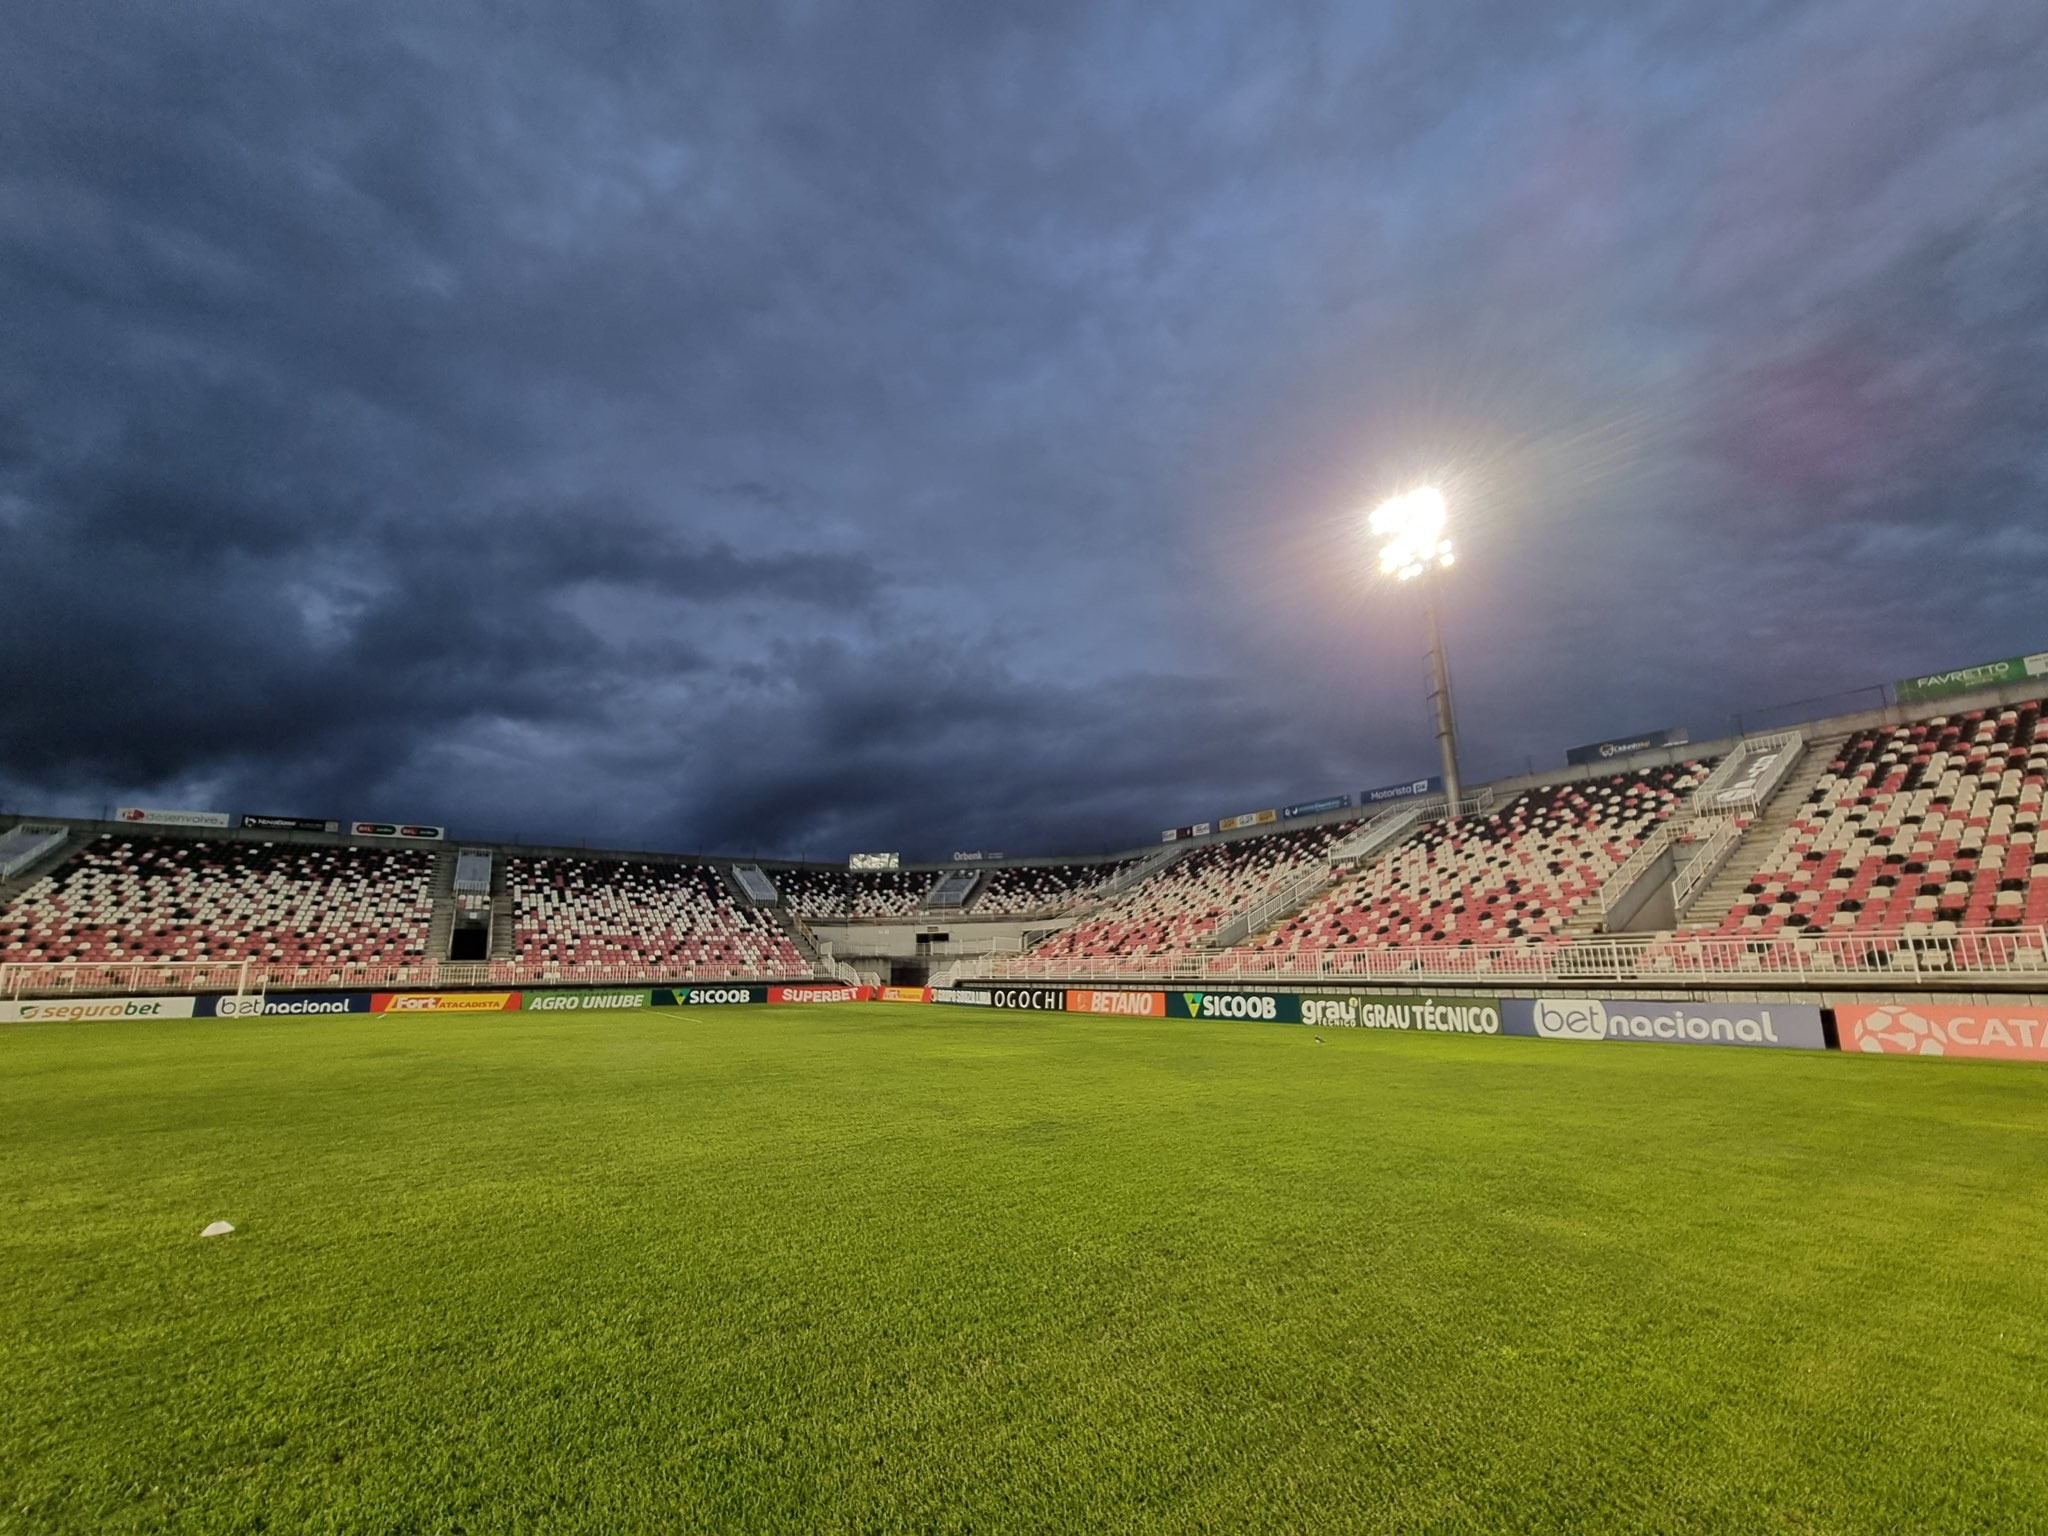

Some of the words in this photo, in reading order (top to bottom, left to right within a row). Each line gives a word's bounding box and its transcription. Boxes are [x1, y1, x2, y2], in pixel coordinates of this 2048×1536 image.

[1918, 662, 2009, 688] FAVRETTO
[1371, 786, 1412, 800] Motorista
[528, 996, 578, 1011] AGRO
[582, 994, 645, 1009] UNIUBE
[689, 989, 750, 1004] SICOOB
[782, 988, 858, 1003] SUPERBET
[994, 990, 1064, 1010] OGOCHI
[1090, 991, 1153, 1015] BETANO
[41, 1001, 162, 1021] segurobet
[1203, 995, 1276, 1019] SICOOB
[1301, 999, 1356, 1025] grau
[1362, 1003, 1411, 1030] GRAU
[1412, 998, 1500, 1035] TÉCNICO
[1947, 1016, 2048, 1048] CAT
